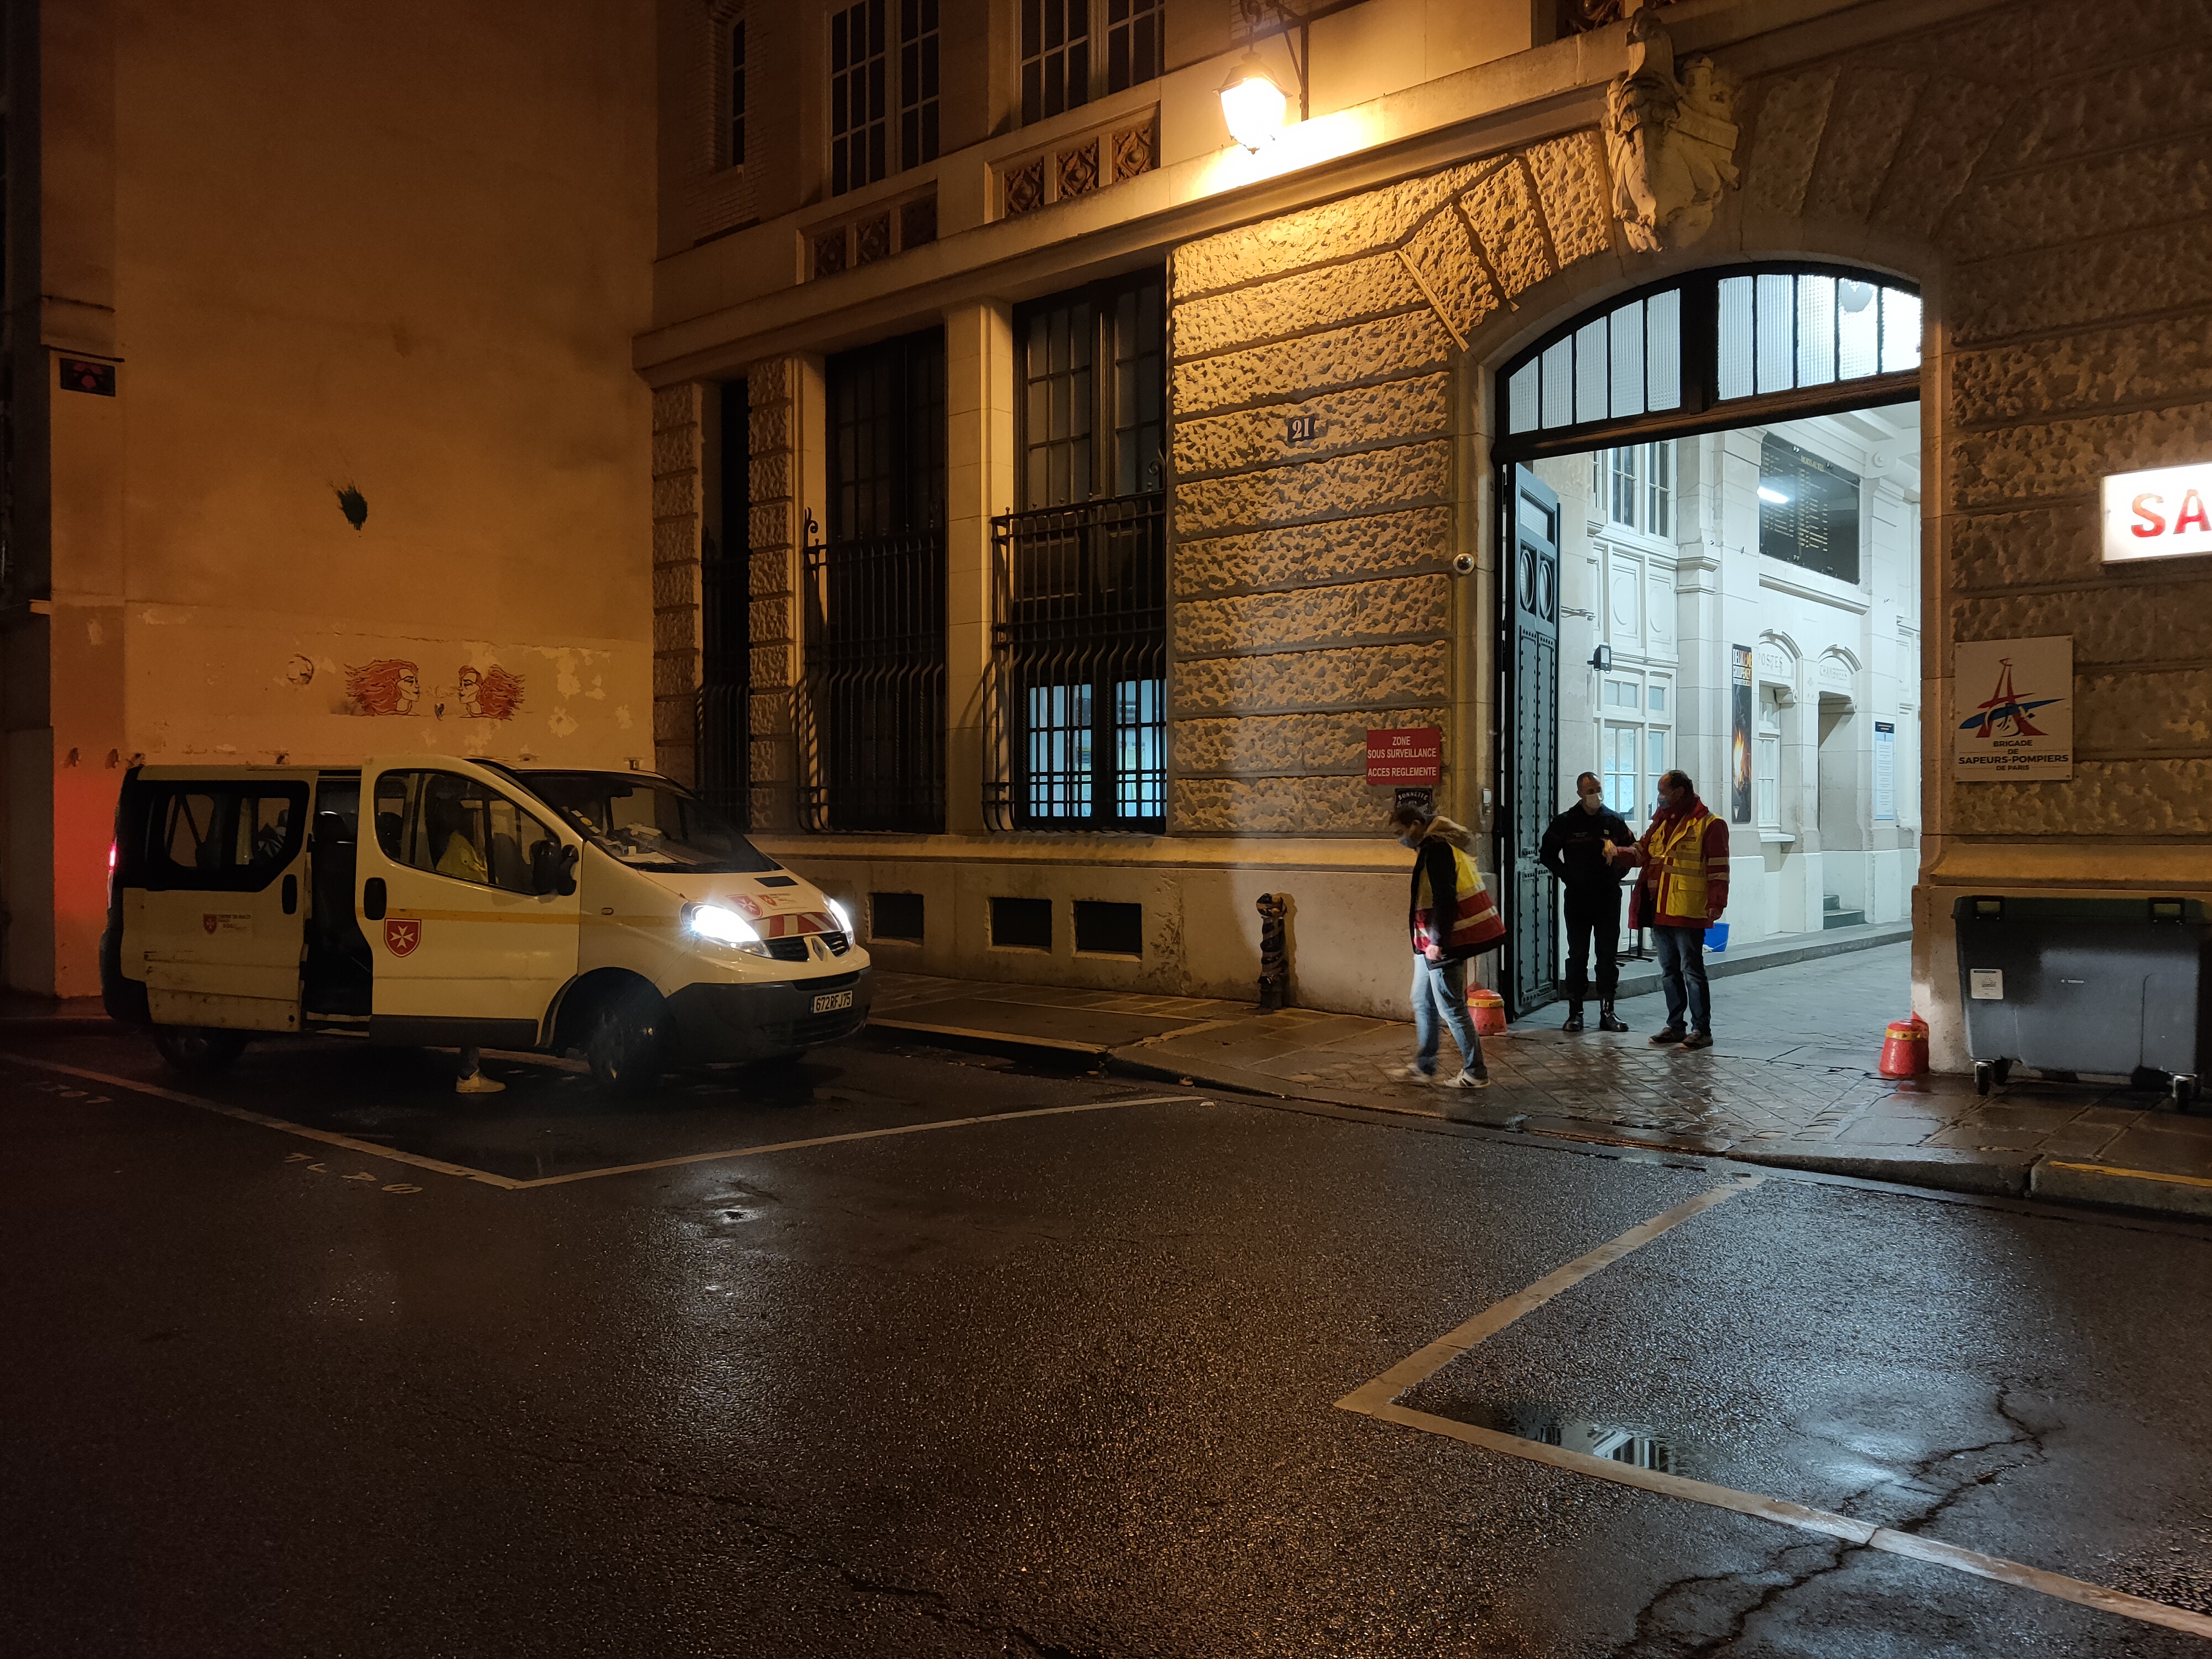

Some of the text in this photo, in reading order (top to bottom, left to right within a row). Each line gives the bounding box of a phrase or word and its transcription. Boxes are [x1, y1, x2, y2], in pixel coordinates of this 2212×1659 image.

[1292, 418, 1310, 439] 21
[2131, 489, 2212, 538] SA
[1392, 736, 1411, 746] ZONE
[1367, 748, 1437, 759] SOUS SURVEILLANCE
[1959, 755, 2069, 764] SAPEURS-POMPIERS
[1368, 766, 1437, 776] ACCES REGLEMENTE
[1398, 791, 1428, 800] SONNETTE
